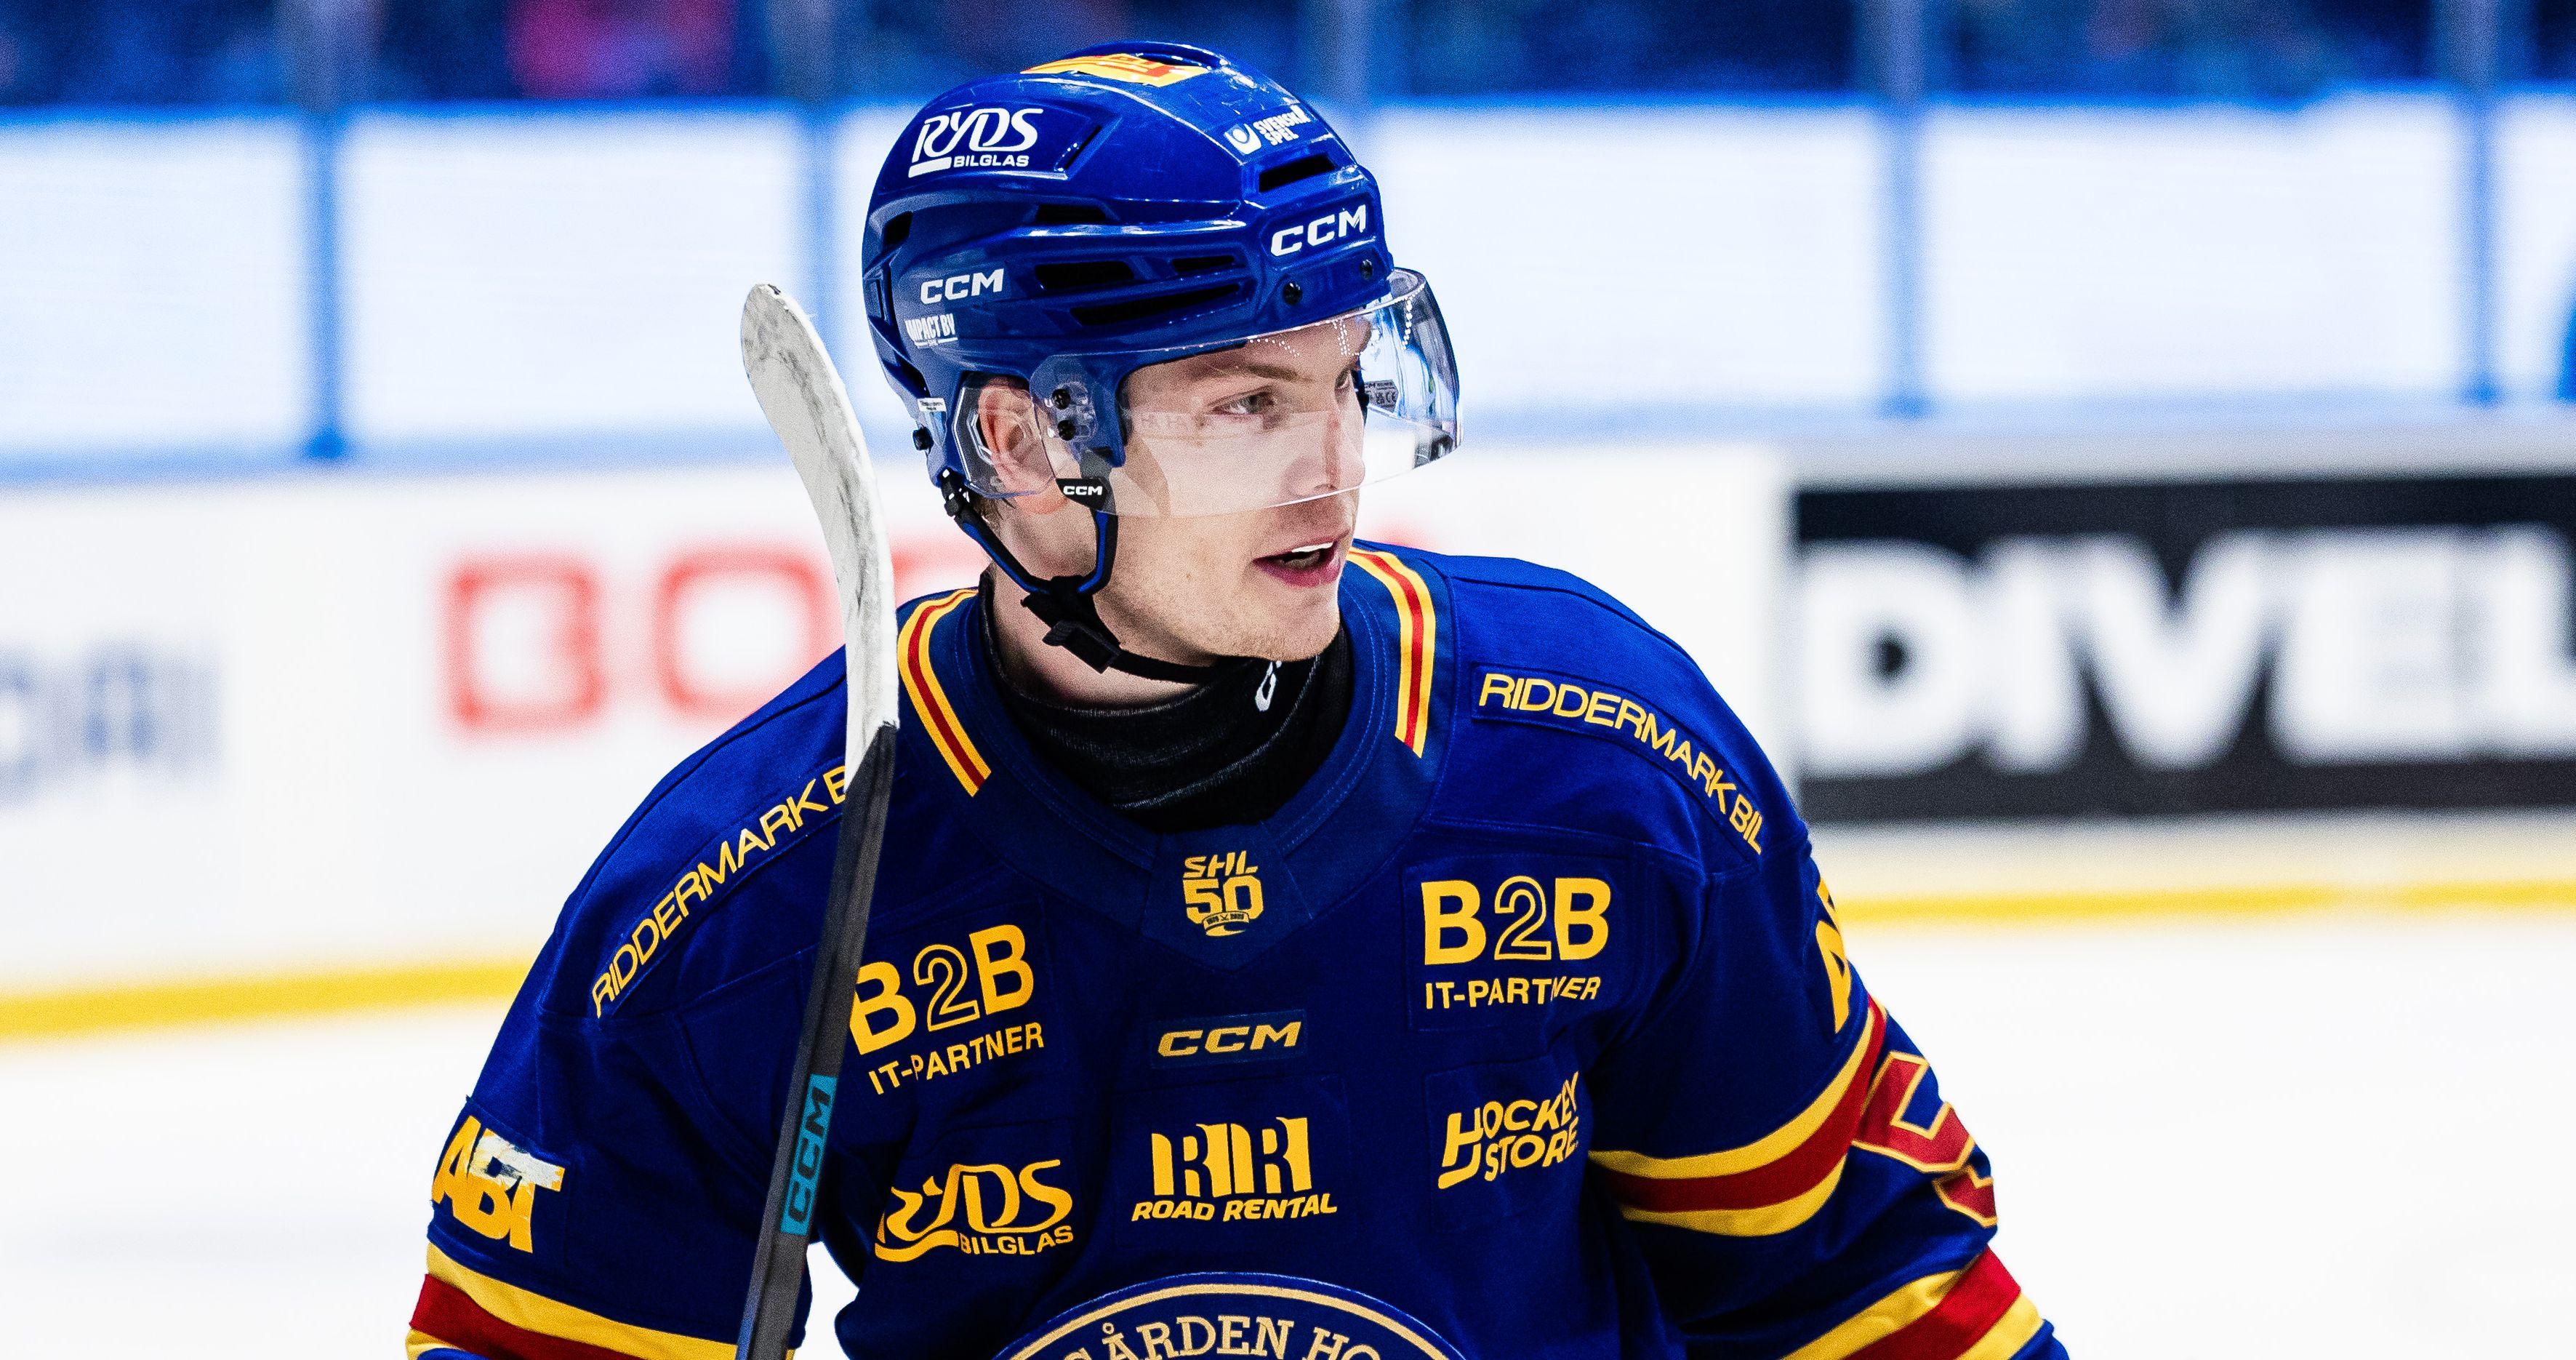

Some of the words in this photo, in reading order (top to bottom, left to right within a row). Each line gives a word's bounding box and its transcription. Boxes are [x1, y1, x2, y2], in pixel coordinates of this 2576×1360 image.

[912, 108, 1044, 163] RYDS
[953, 154, 1030, 167] BILGLAS
[1264, 127, 1299, 145] SPEL
[1270, 204, 1366, 257] CCM
[920, 268, 1004, 305] CCM
[904, 315, 941, 340] IMPACT
[939, 313, 955, 337] BY
[1063, 485, 1103, 495] CCM
[1479, 673, 1736, 814] RIDDERMARK
[1729, 793, 1763, 855] BIL
[1183, 850, 1259, 878] SHL
[592, 778, 829, 1018] RIDDERMARK
[1183, 875, 1264, 924] 50
[1421, 875, 1611, 966] B2B
[849, 924, 1034, 1055] B2B
[1425, 976, 1601, 1009] IT-PARTNER
[868, 1022, 1044, 1095] IT-PARTNER
[1158, 1021, 1301, 1057] CCM
[788, 1087, 830, 1220] CCM
[1437, 1071, 1579, 1189] HOCKEY
[1484, 1116, 1579, 1182] STORE
[431, 1115, 565, 1254] ABT
[877, 1159, 1072, 1244] RYDS
[1131, 1200, 1215, 1222] ROAD
[1223, 1193, 1338, 1222] RENTAL
[960, 1225, 1074, 1255] BILGLAS
